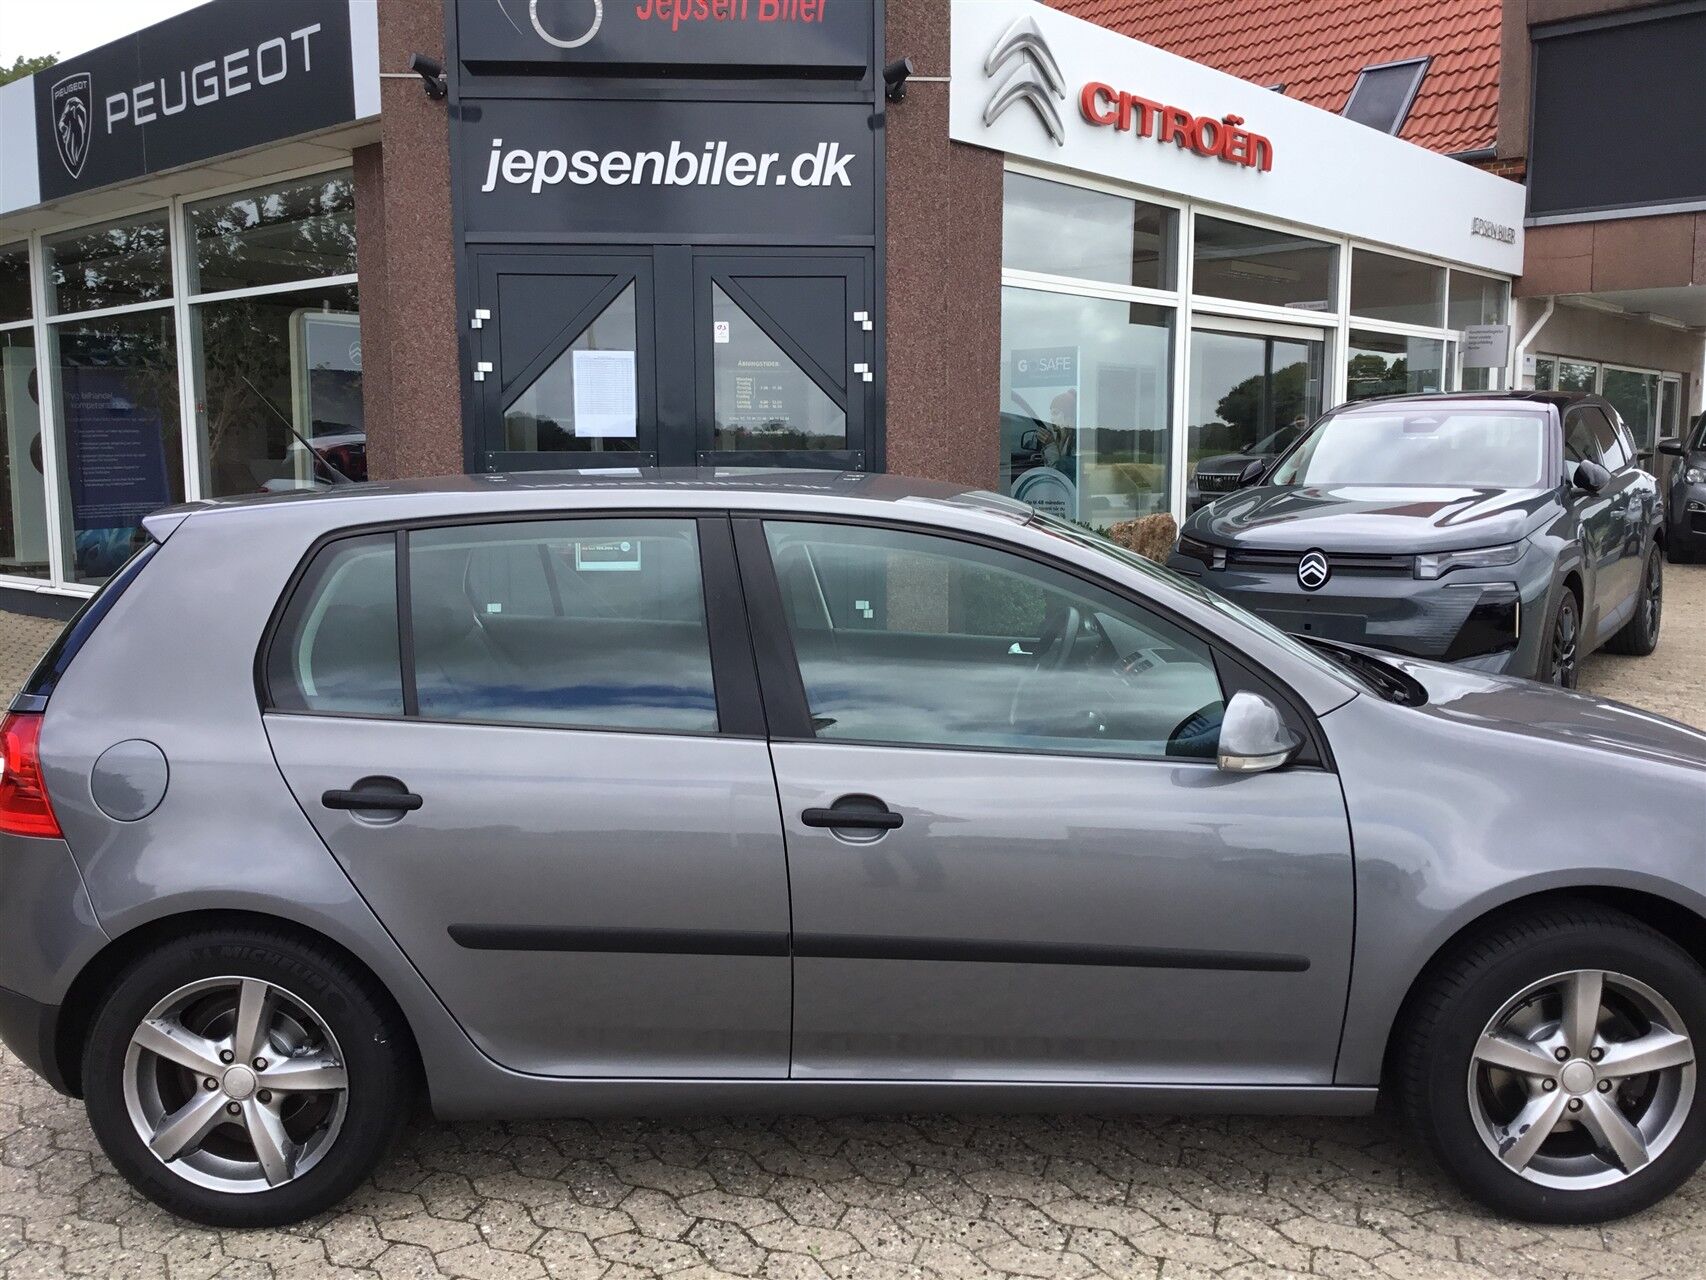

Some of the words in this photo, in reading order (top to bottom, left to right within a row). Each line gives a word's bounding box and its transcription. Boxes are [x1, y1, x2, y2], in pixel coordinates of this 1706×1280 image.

[54, 79, 88, 99] PEUGEOT
[106, 23, 321, 134] PEUGEOT
[481, 138, 856, 194] jepsenbiler.dk
[1472, 217, 1498, 239] JEPSEN
[1499, 225, 1516, 245] BILER
[1040, 356, 1071, 372] SAFE
